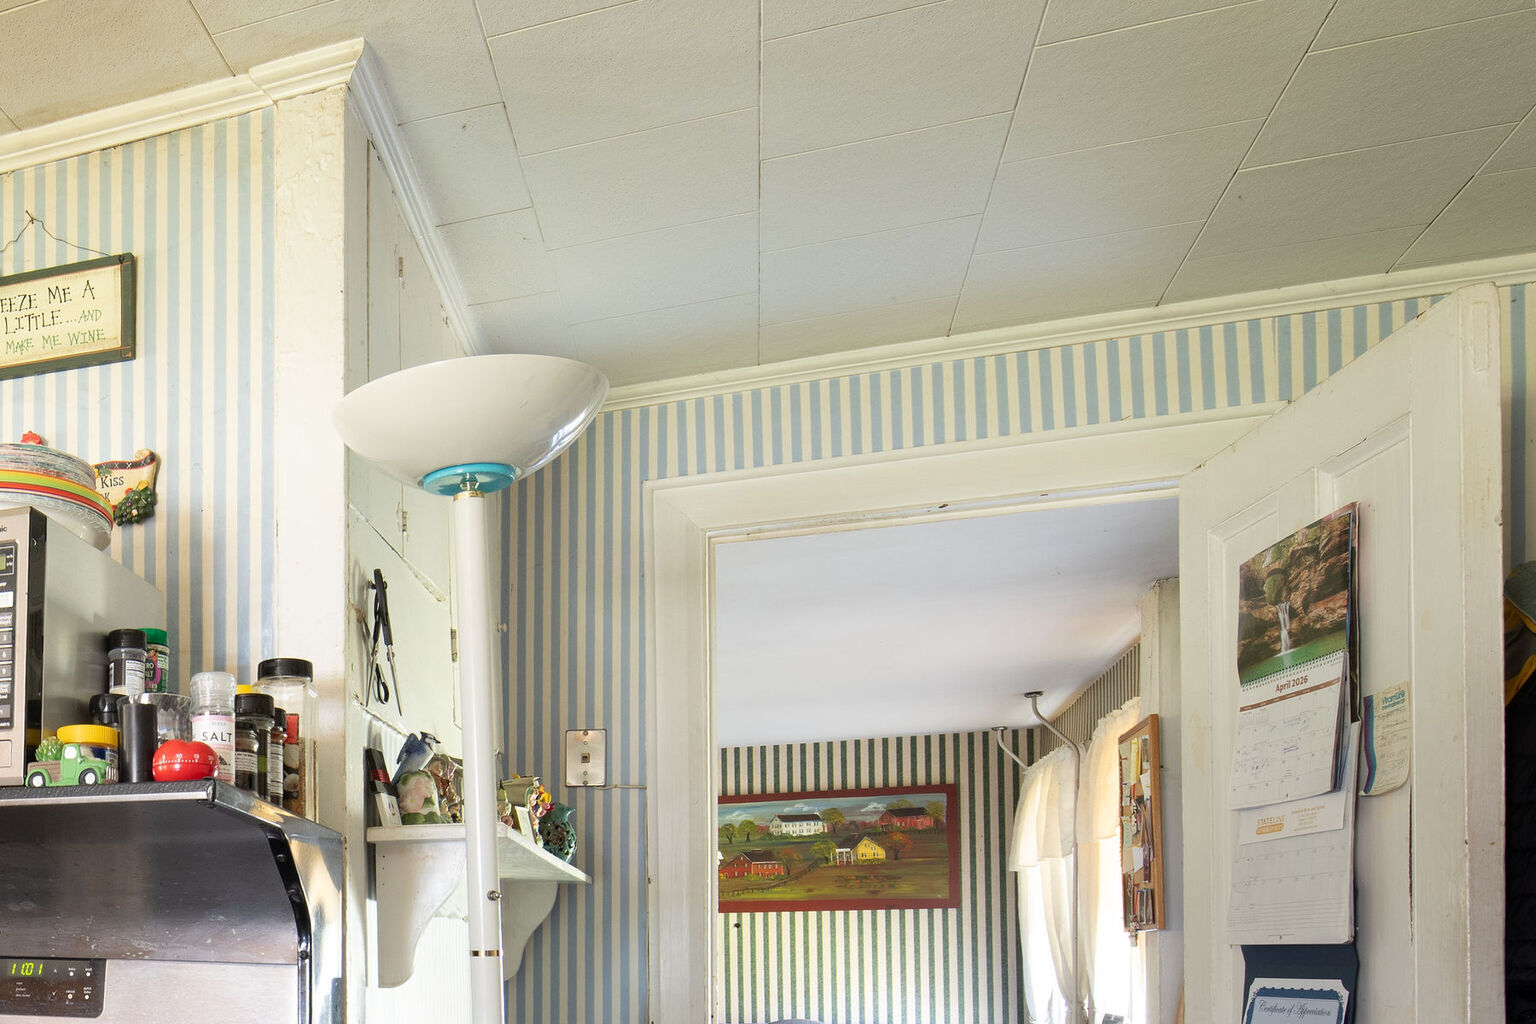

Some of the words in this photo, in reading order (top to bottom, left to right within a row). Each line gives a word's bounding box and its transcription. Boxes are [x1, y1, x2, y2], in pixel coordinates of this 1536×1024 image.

[47, 285, 72, 304] ME
[81, 279, 96, 300] A
[5, 337, 35, 356] MAKE
[42, 334, 62, 350] ME
[67, 328, 106, 346] WINE
[1275, 680, 1291, 694] April
[1291, 675, 1309, 688] 2026
[202, 731, 233, 742] SALT
